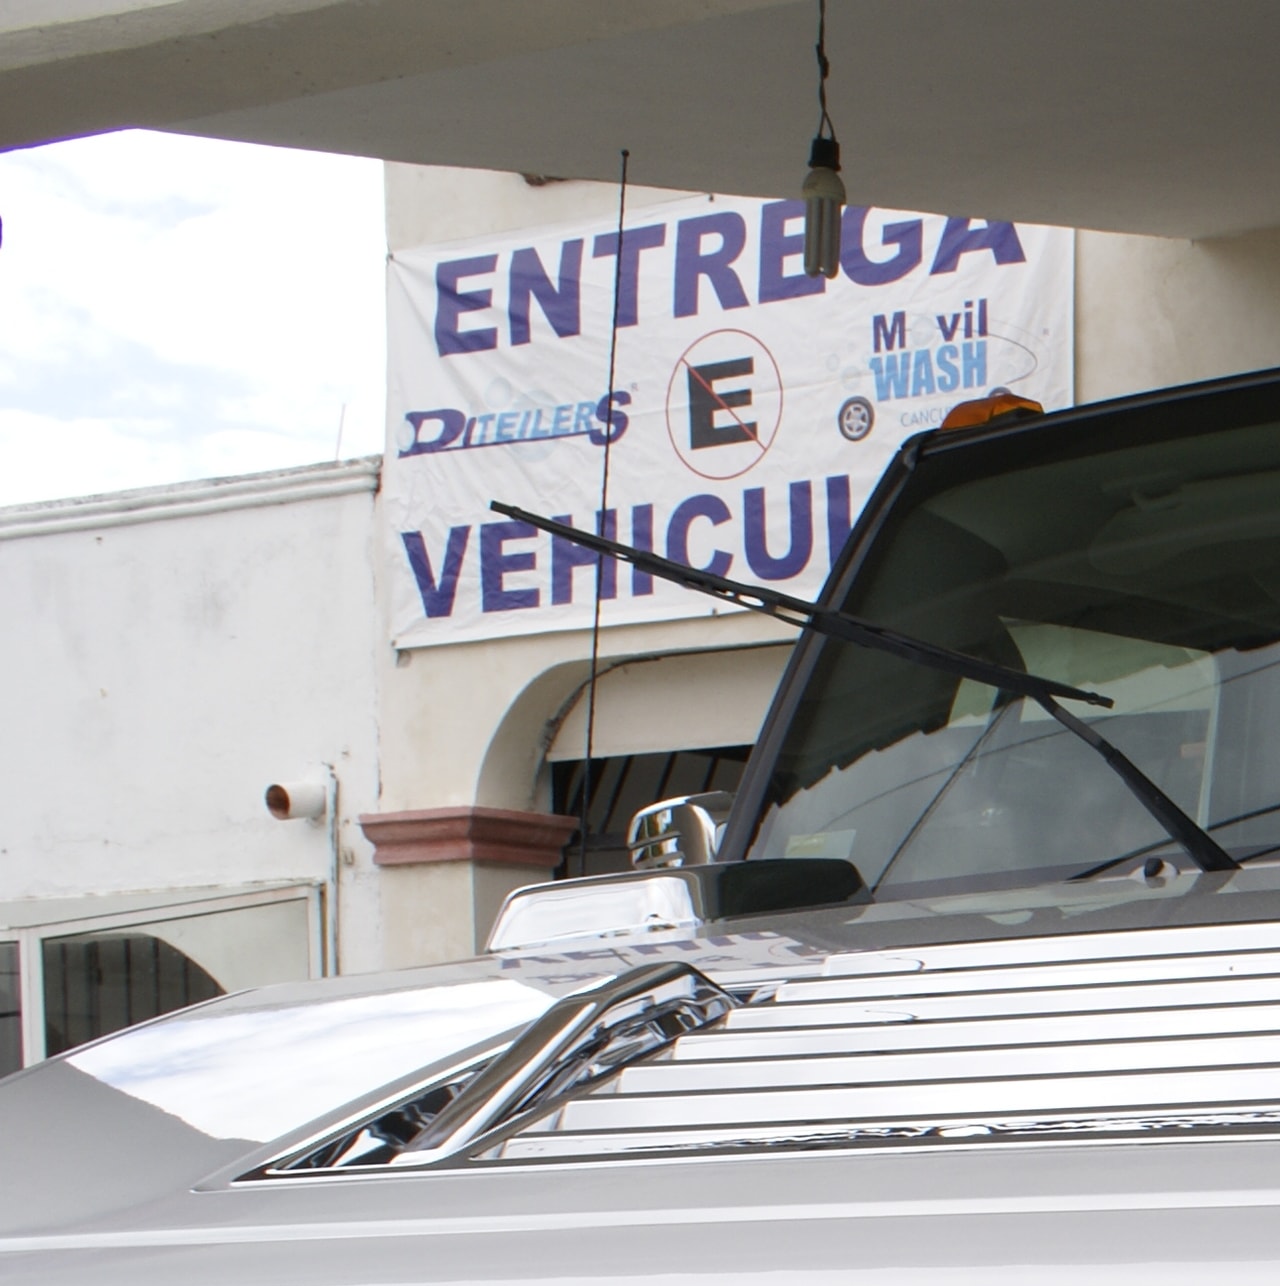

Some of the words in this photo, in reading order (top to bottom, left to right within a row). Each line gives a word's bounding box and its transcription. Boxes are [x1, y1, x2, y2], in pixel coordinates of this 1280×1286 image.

[435, 201, 1026, 356] ENTREGA
[687, 357, 758, 450] E
[869, 341, 987, 402] WASH
[901, 408, 950, 427] CANCU
